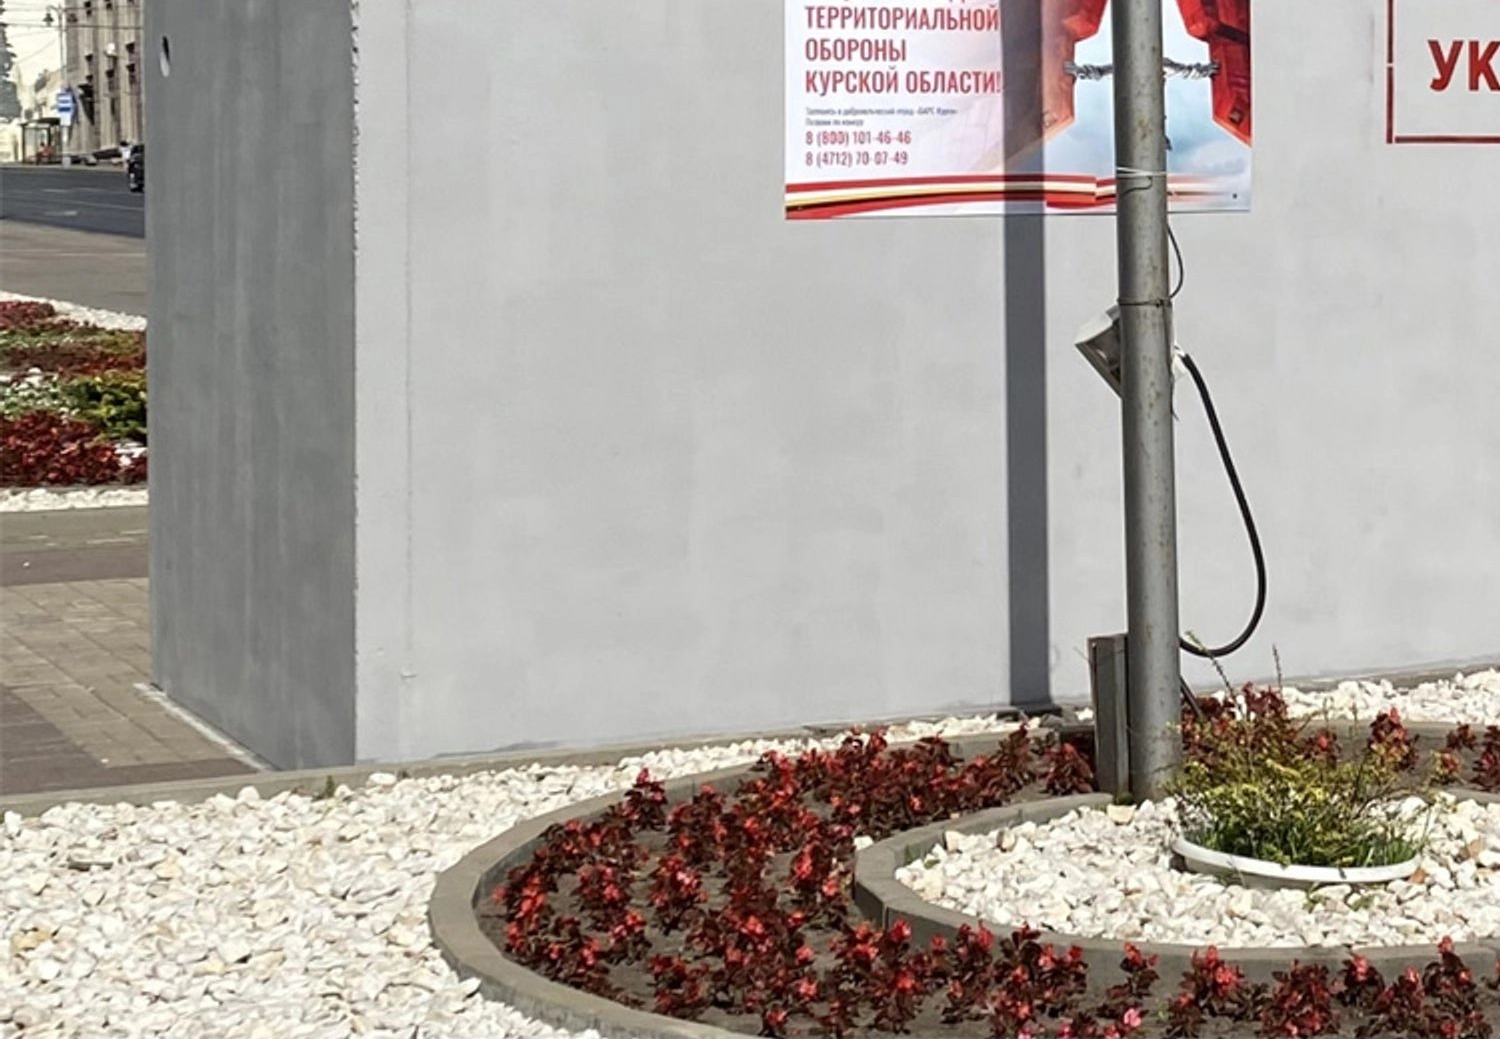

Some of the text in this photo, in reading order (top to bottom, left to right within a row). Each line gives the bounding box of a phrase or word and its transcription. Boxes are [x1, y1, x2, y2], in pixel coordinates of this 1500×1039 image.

[804, 3, 999, 31] ТЕРРИТОРИАЛЬНОЙ
[804, 37, 907, 62] ОБОРОНЫ
[805, 65, 1002, 96] КУРСКОЙ ОБЛАСТИ!
[805, 130, 912, 148] 8 (800) 101-46-46
[805, 151, 909, 169] 8 (4712) 70-07-49
